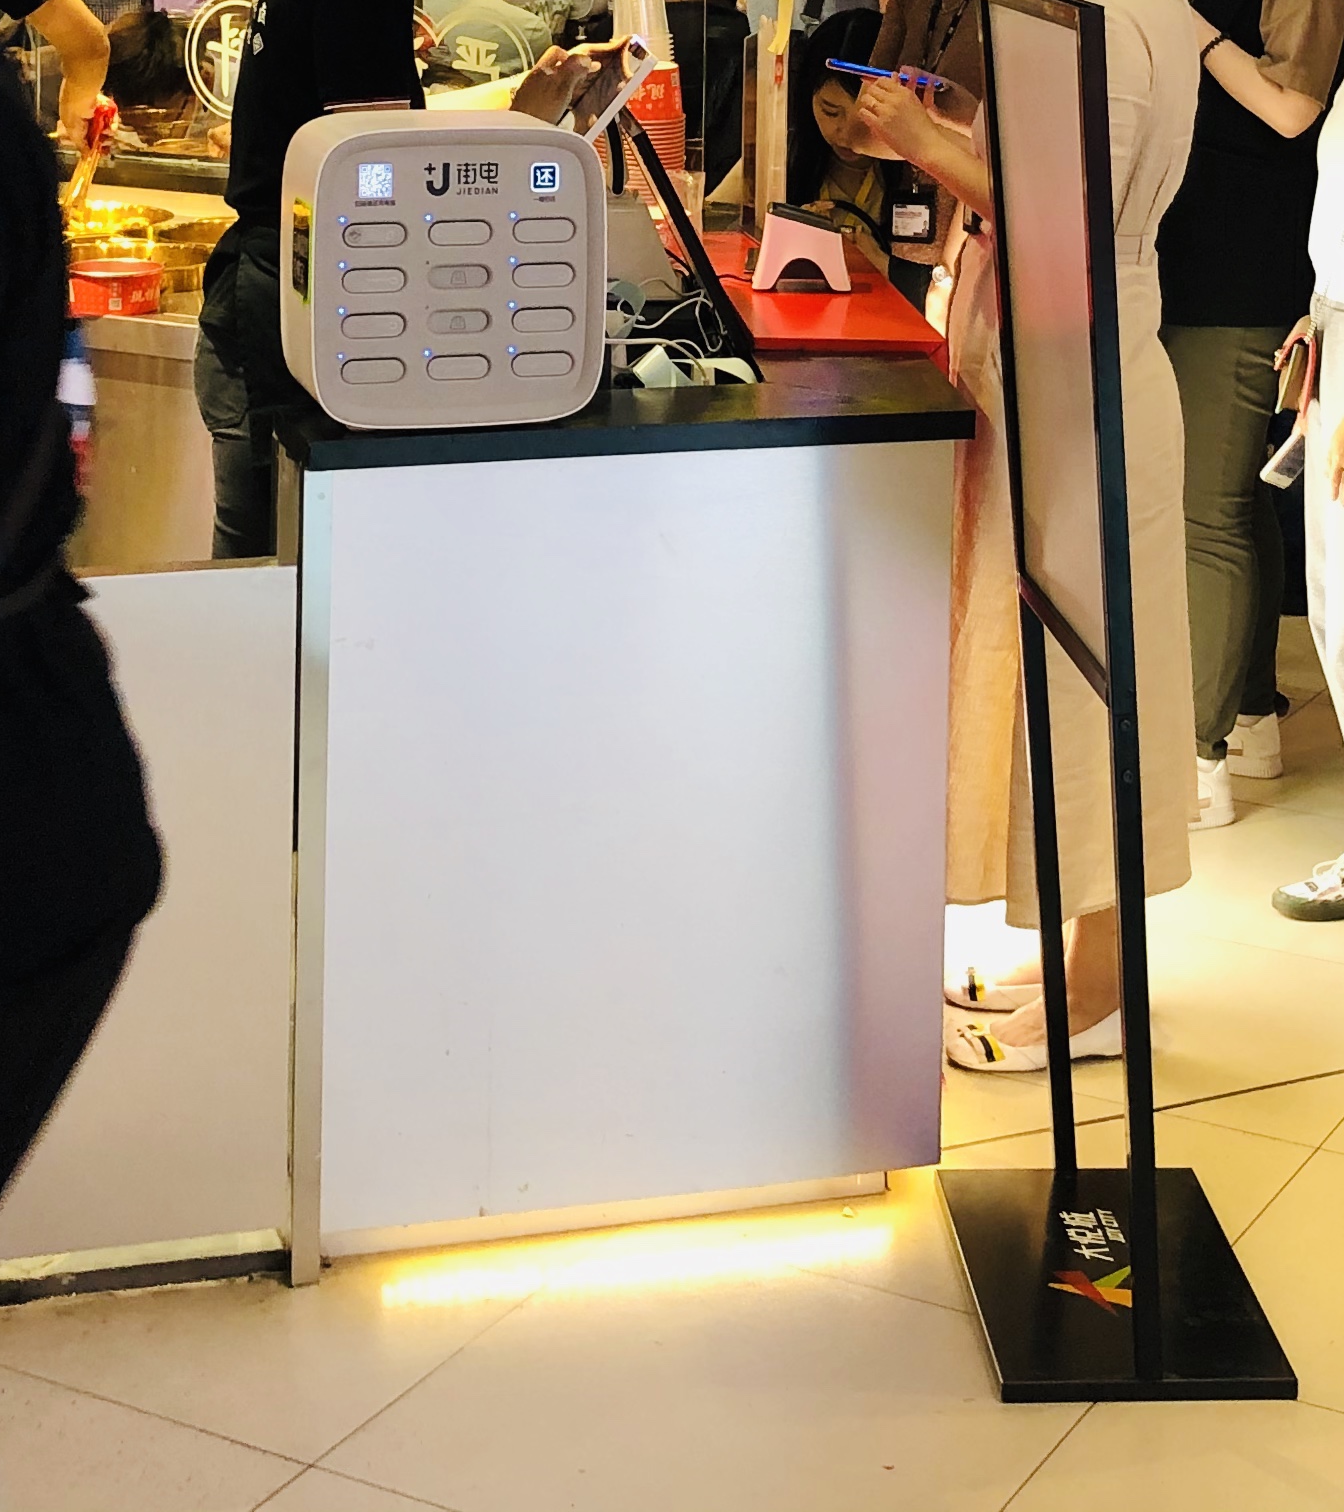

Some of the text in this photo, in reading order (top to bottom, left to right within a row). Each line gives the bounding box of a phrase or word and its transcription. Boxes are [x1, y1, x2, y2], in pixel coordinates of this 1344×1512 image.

[456, 162, 499, 185] 街电
[536, 168, 554, 186] 还
[456, 187, 499, 196] JIEDIAN
